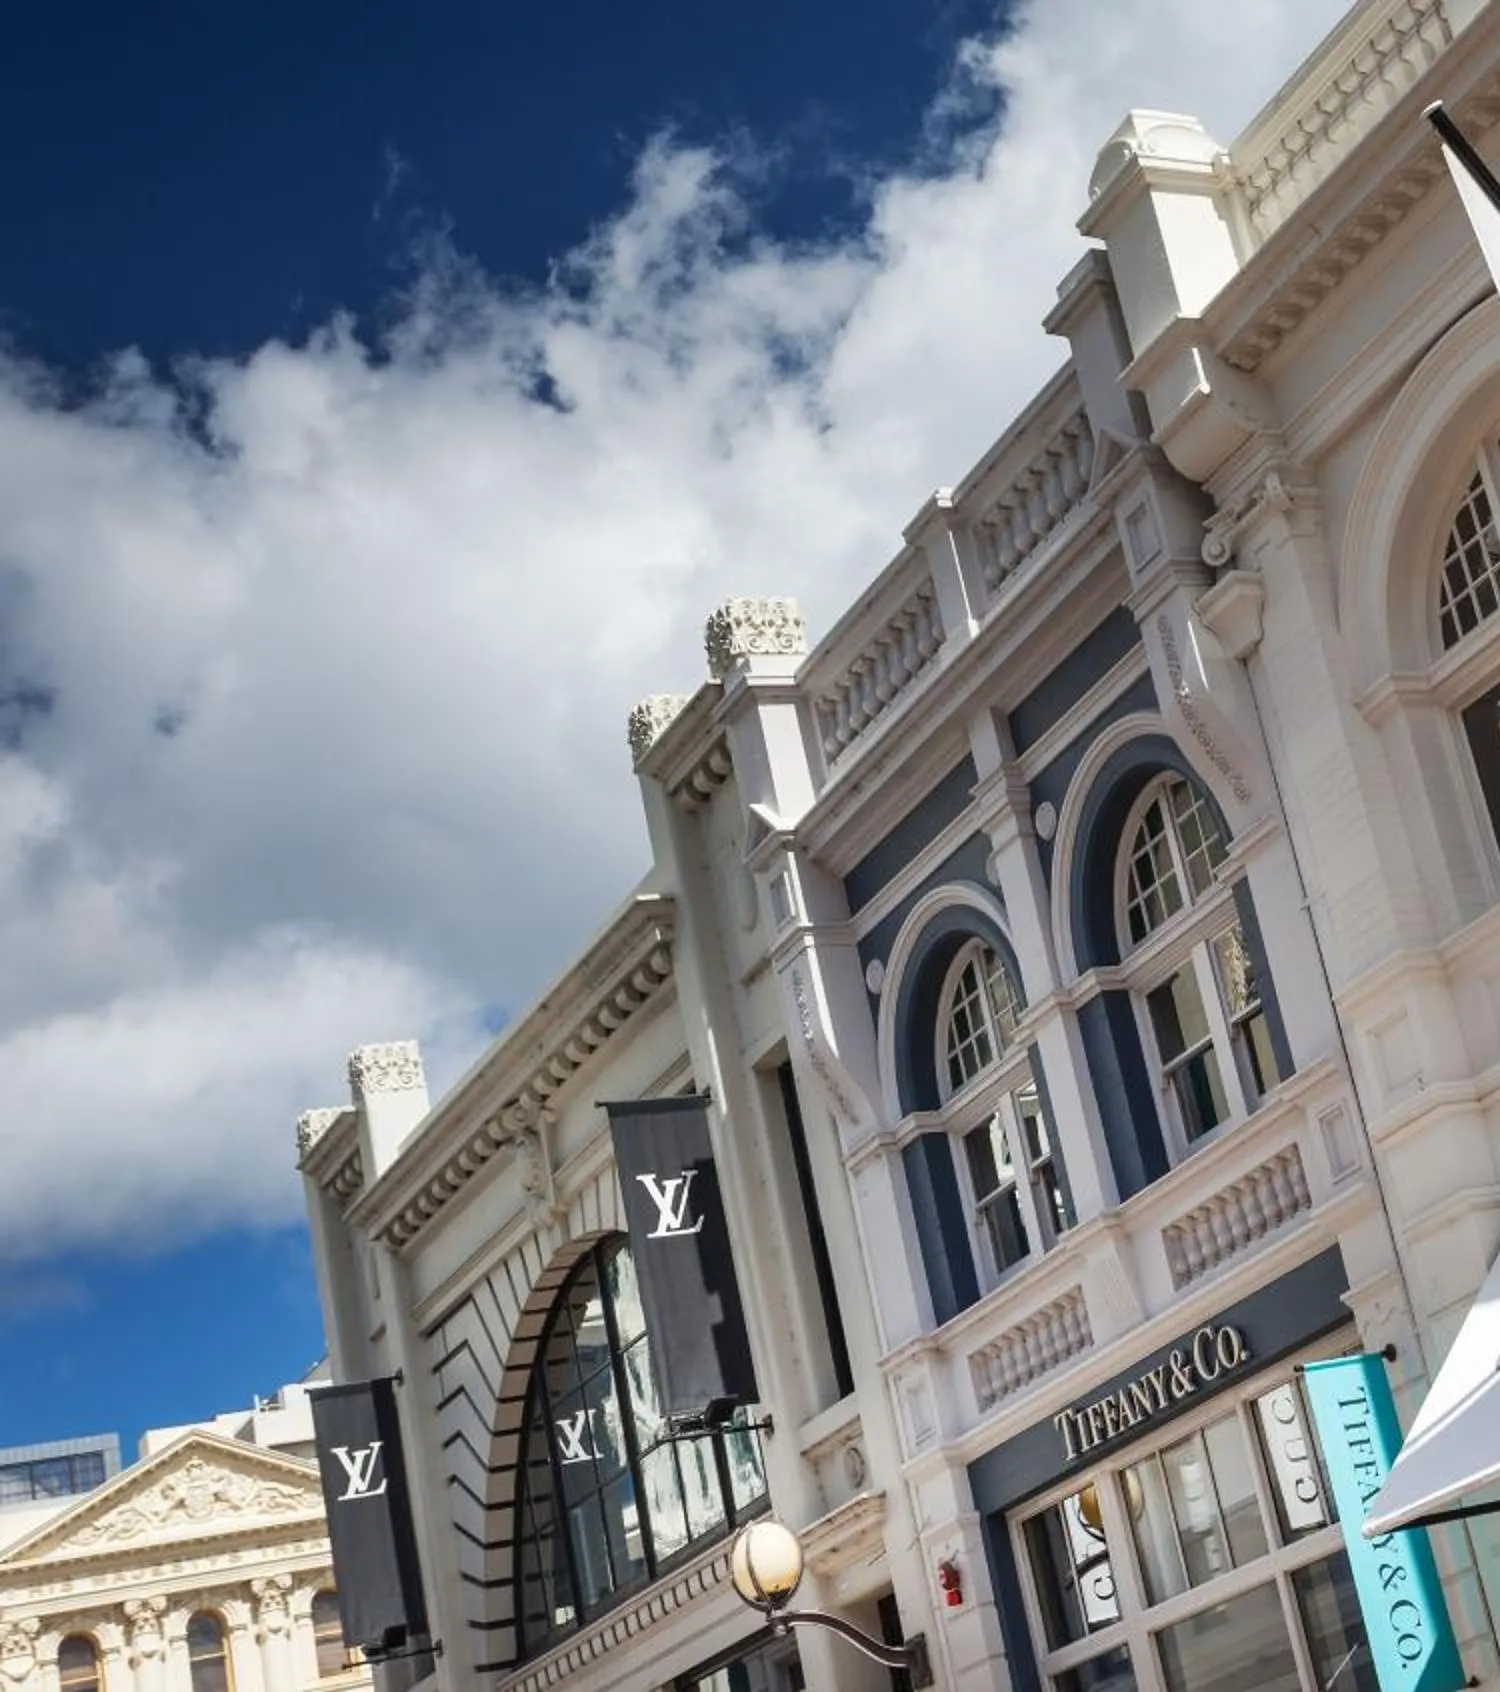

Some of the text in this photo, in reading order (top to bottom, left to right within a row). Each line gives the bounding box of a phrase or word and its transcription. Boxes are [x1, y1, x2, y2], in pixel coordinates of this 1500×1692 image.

[635, 1169, 705, 1239] LV
[330, 1440, 388, 1502] LV
[1337, 1385, 1423, 1670] TIFFAY & CO.
